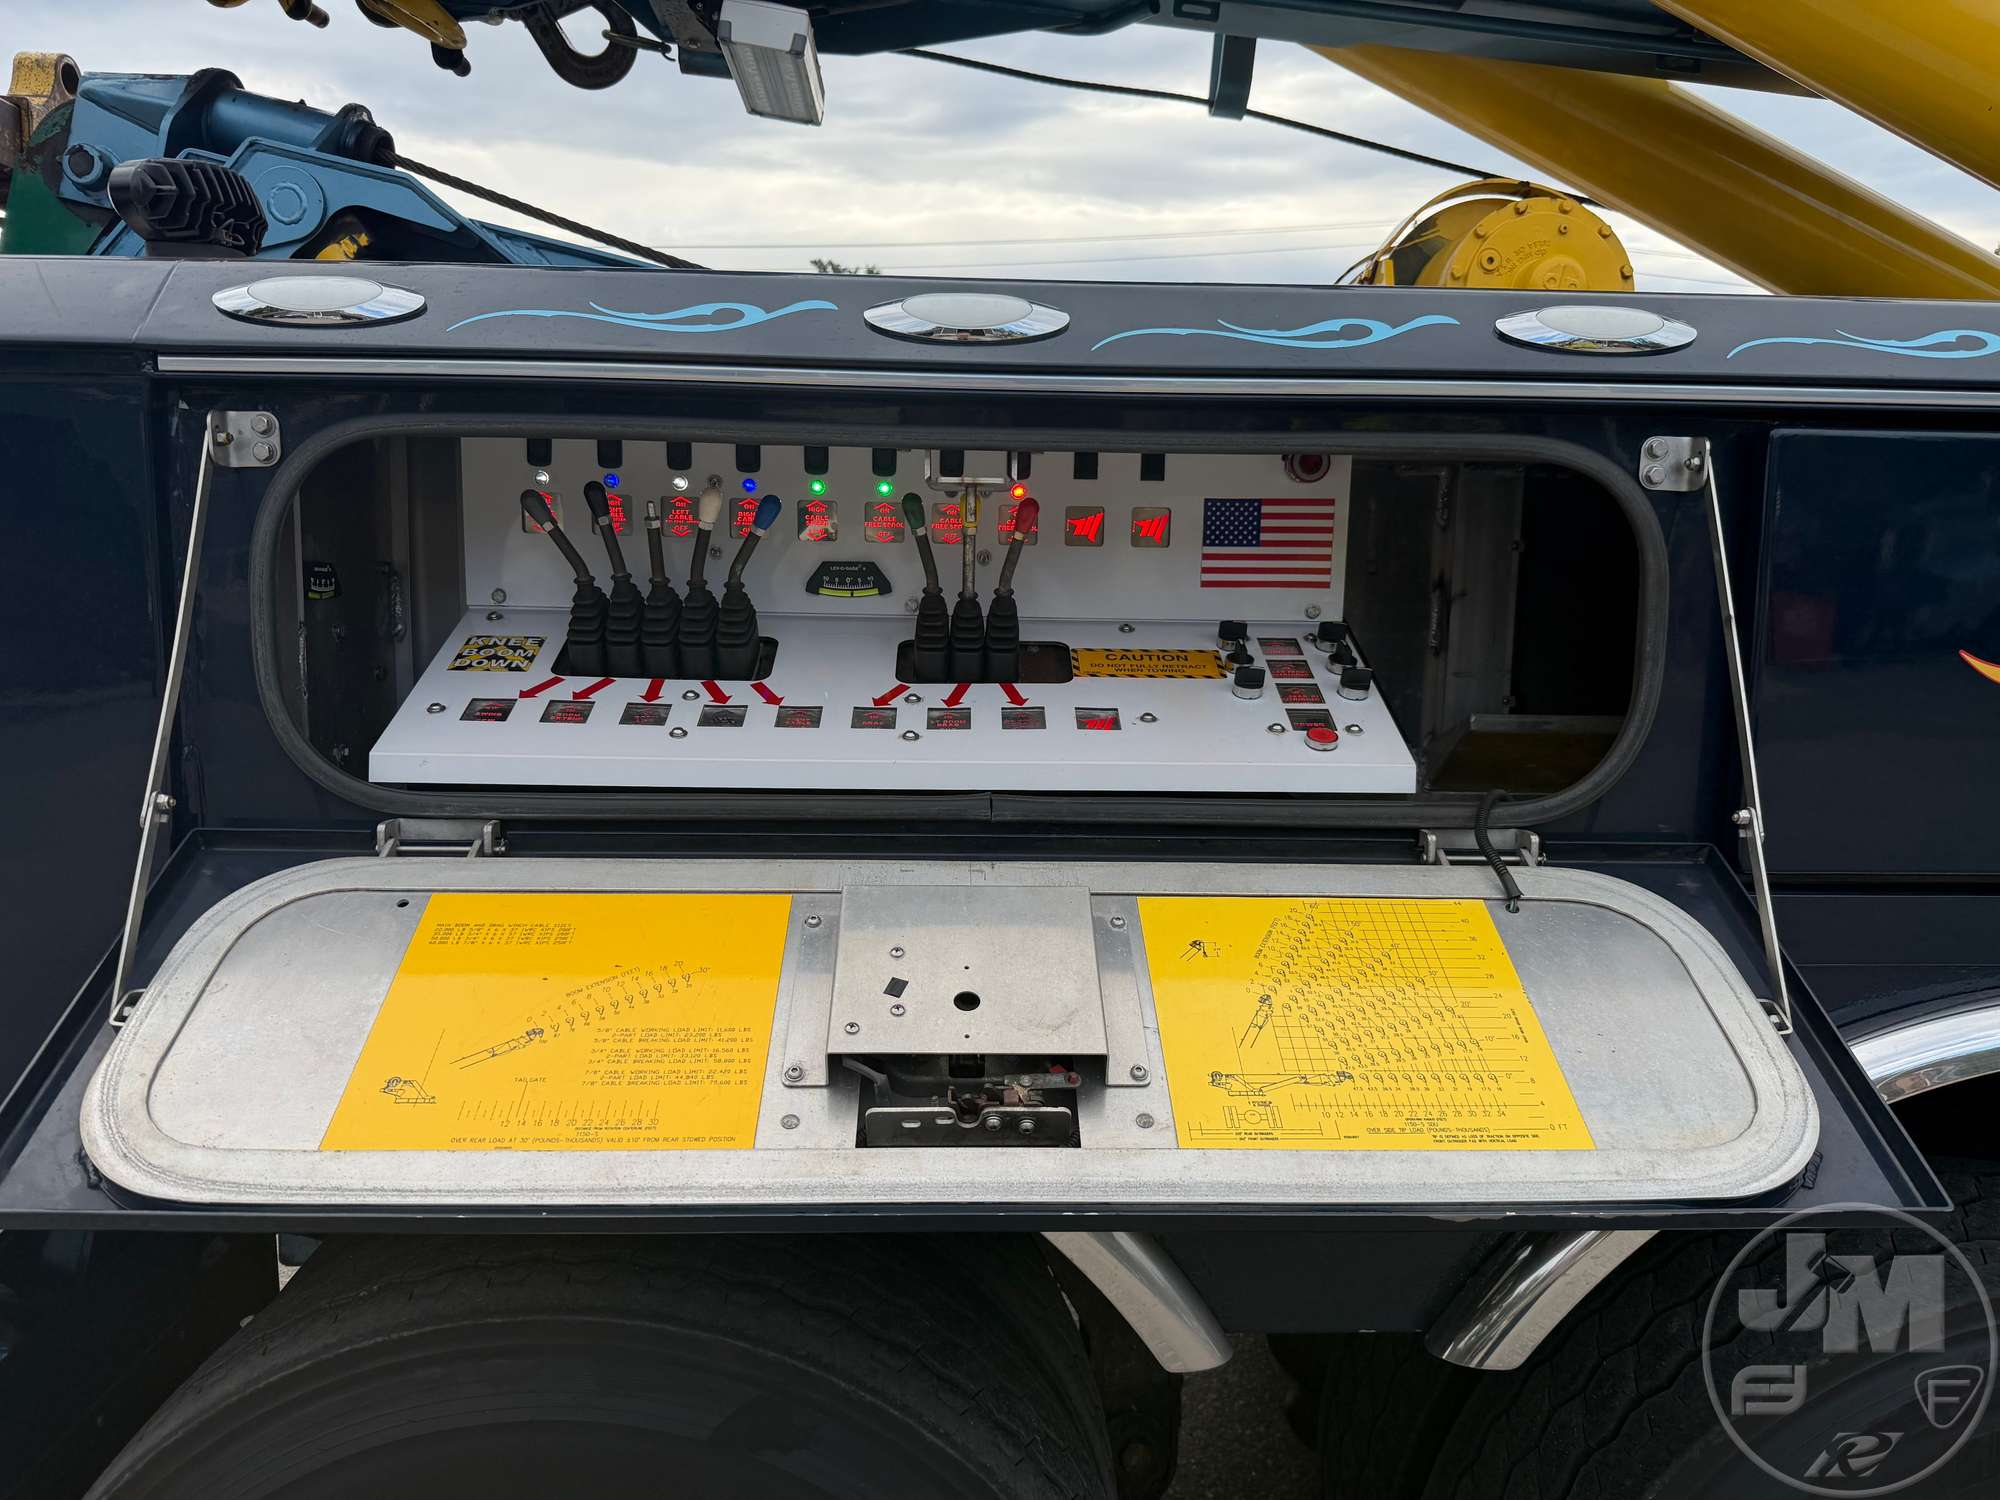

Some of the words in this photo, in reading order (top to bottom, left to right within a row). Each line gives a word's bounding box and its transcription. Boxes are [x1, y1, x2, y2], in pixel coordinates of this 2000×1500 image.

[468, 636, 542, 646] KNEE
[462, 648, 534, 658] BOOM
[1105, 653, 1189, 662] CAUTION
[454, 659, 530, 668] DOWN
[586, 975, 618, 990] EXTENSION
